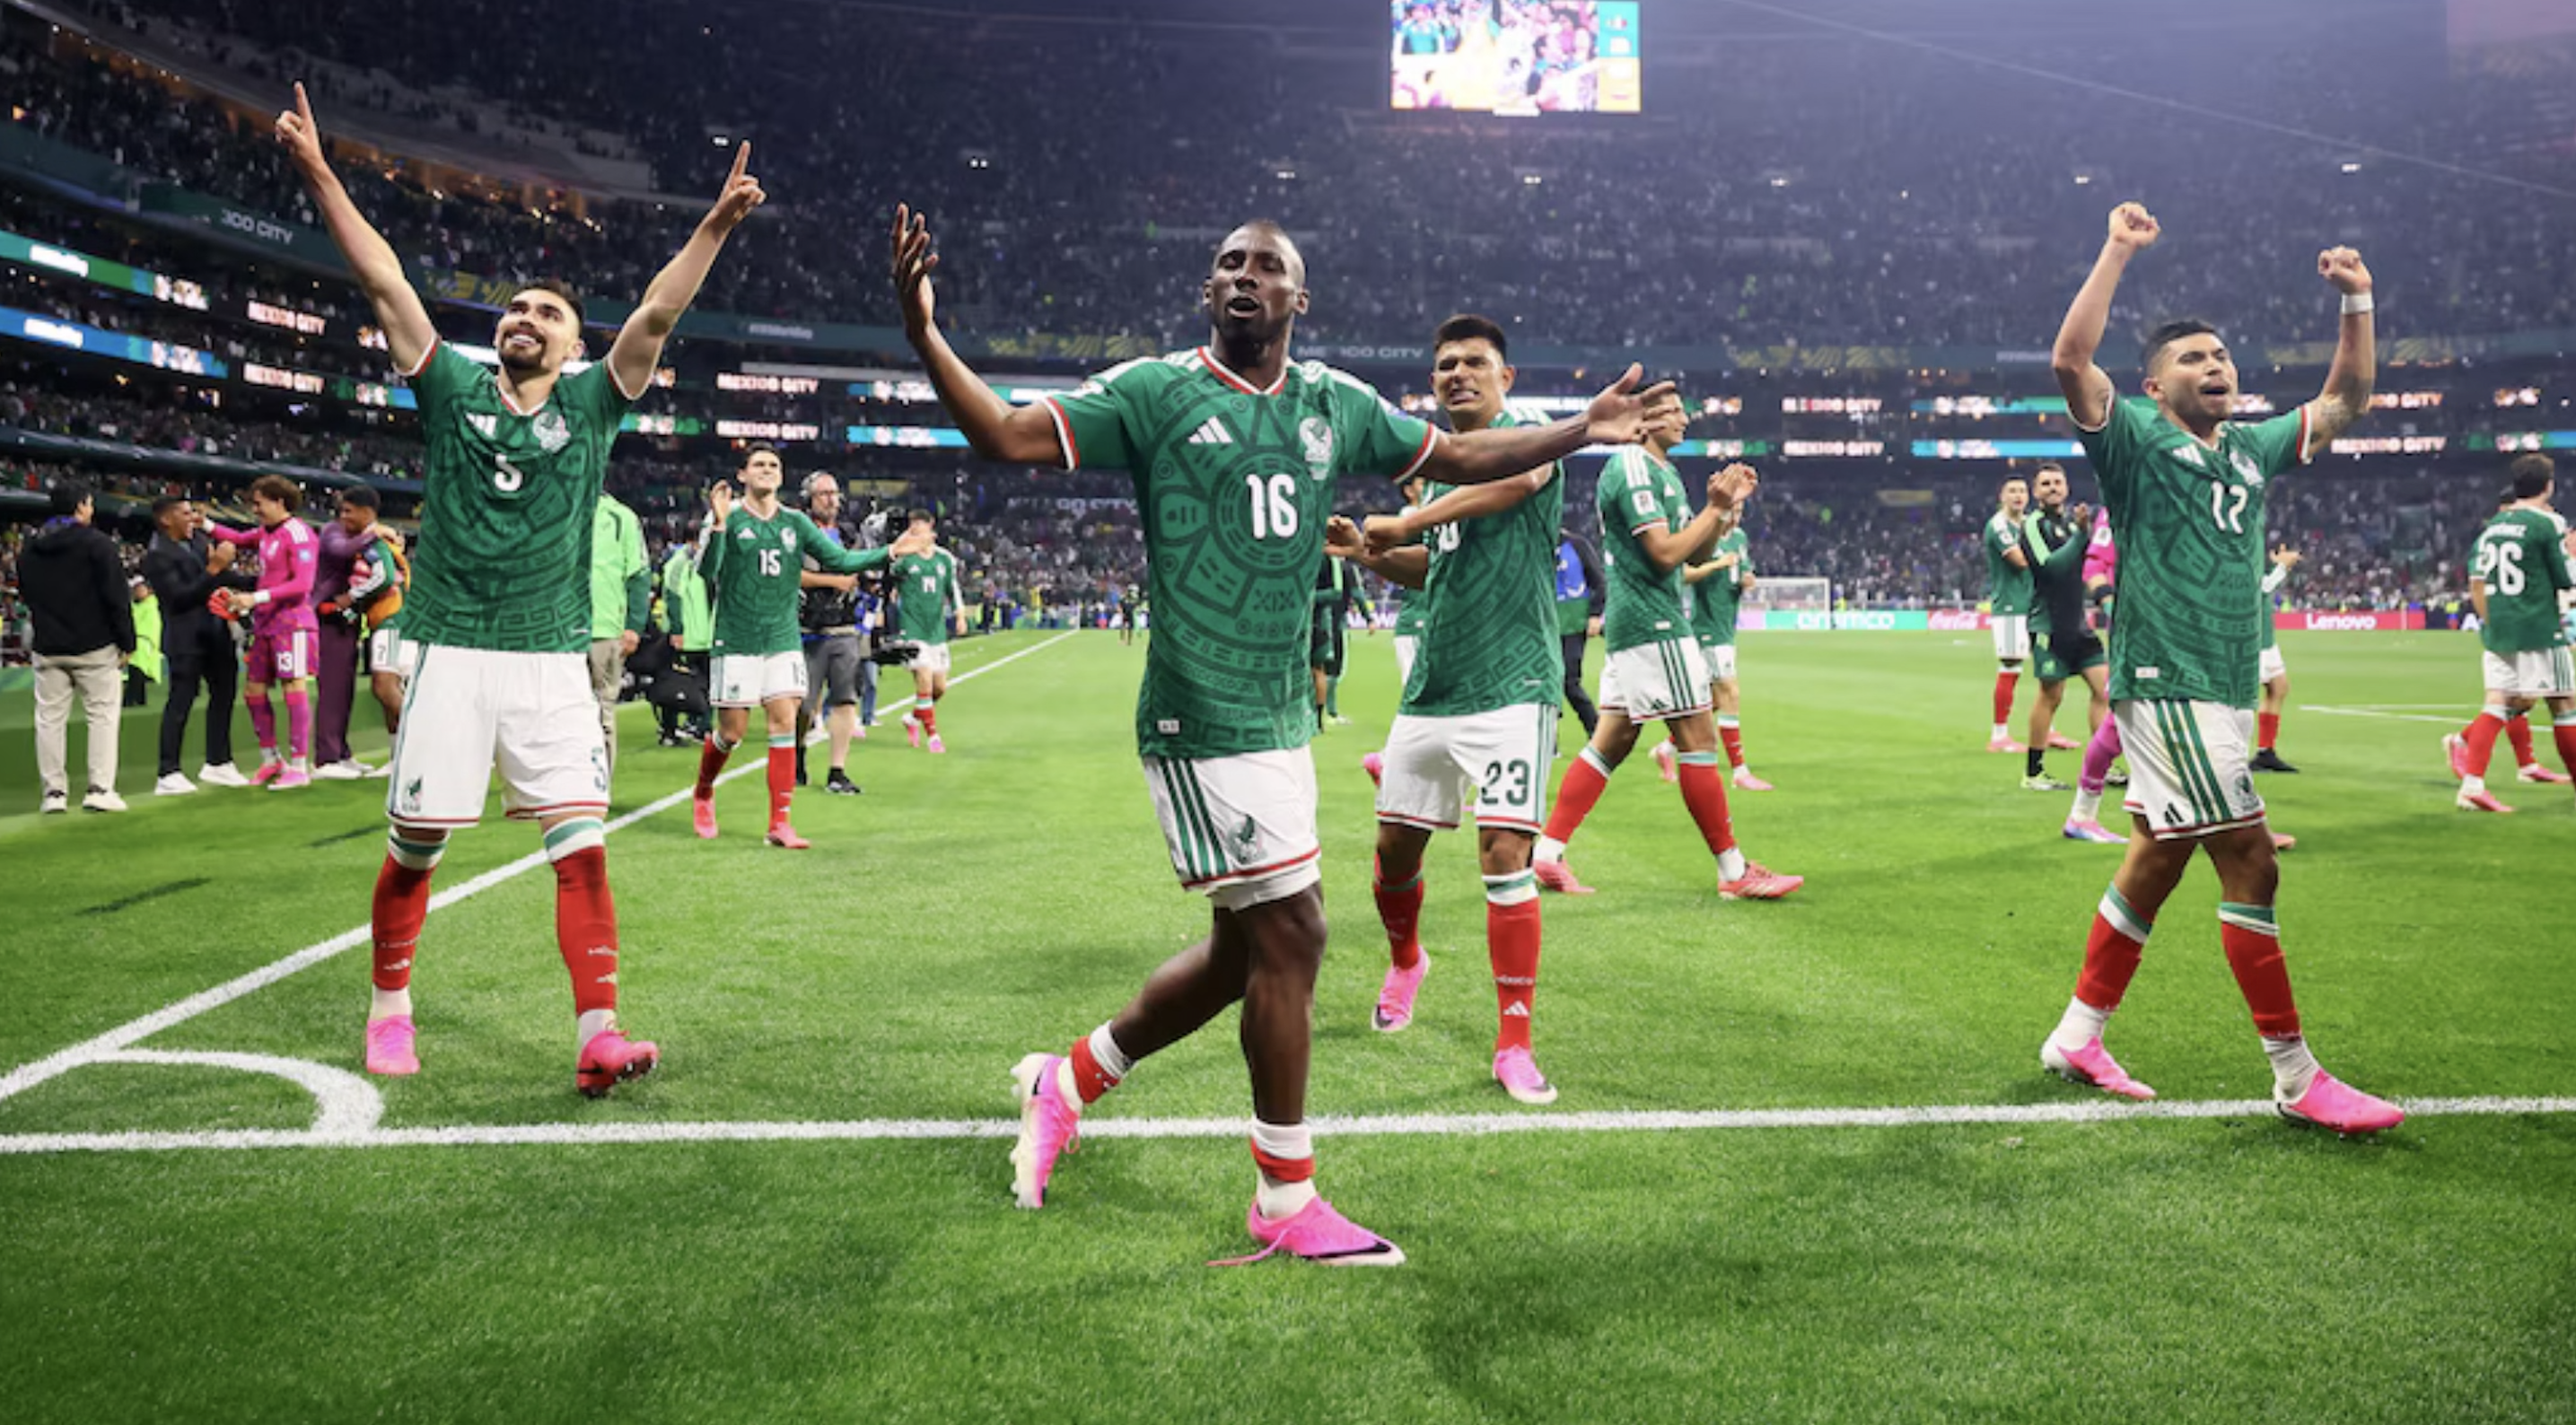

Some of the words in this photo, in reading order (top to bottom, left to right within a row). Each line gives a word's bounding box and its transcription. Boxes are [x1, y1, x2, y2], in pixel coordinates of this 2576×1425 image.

[1379, 345, 1424, 358] CITY
[717, 373, 780, 392] MEXICO
[781, 378, 819, 393] CITY
[2400, 392, 2442, 409] CITY
[716, 420, 780, 438] MEXICO
[781, 424, 819, 441] CITY
[1845, 441, 1884, 457] CITY
[2403, 436, 2447, 453] CITY
[495, 452, 523, 492] 5
[1246, 474, 1298, 538] 16
[2212, 480, 2248, 534] 17
[758, 549, 780, 576] 15
[2479, 541, 2526, 595] 26
[2306, 613, 2378, 628] Lenovo
[276, 651, 294, 672] 13
[1481, 759, 1529, 806] 23
